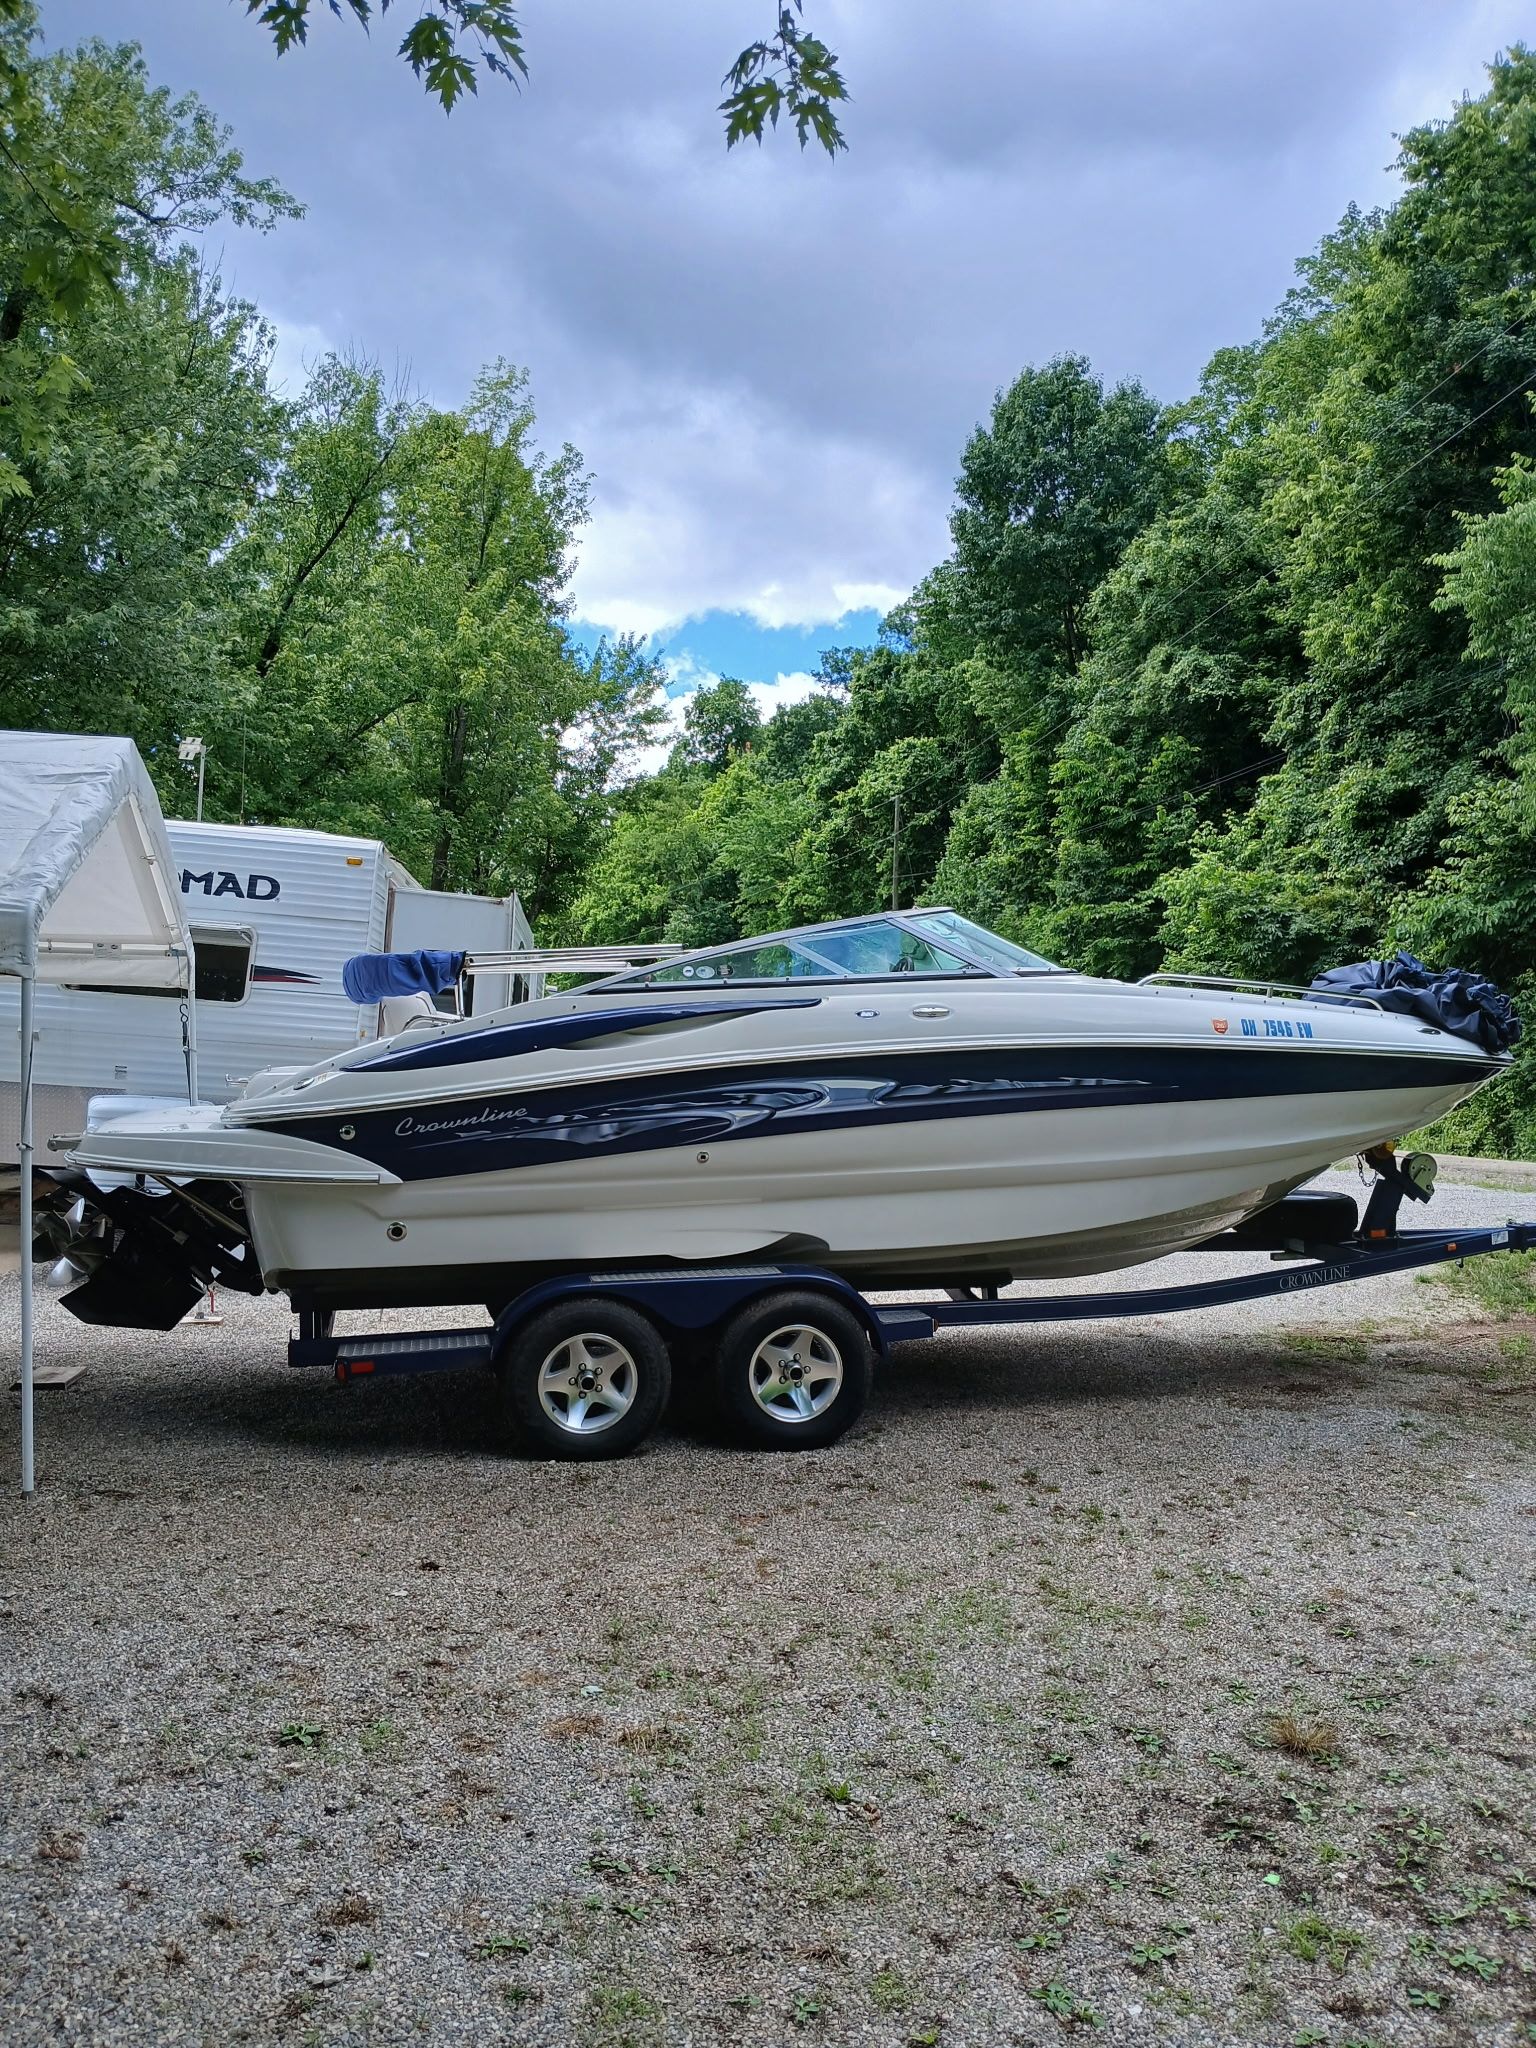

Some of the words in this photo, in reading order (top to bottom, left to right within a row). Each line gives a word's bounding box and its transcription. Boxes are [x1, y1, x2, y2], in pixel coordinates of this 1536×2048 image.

[177, 868, 281, 901] MAD
[1240, 1018, 1257, 1036] OH
[1263, 1019, 1293, 1037] 7546
[394, 1107, 527, 1136] Crownline
[1279, 1265, 1350, 1290] CROWNLINE
